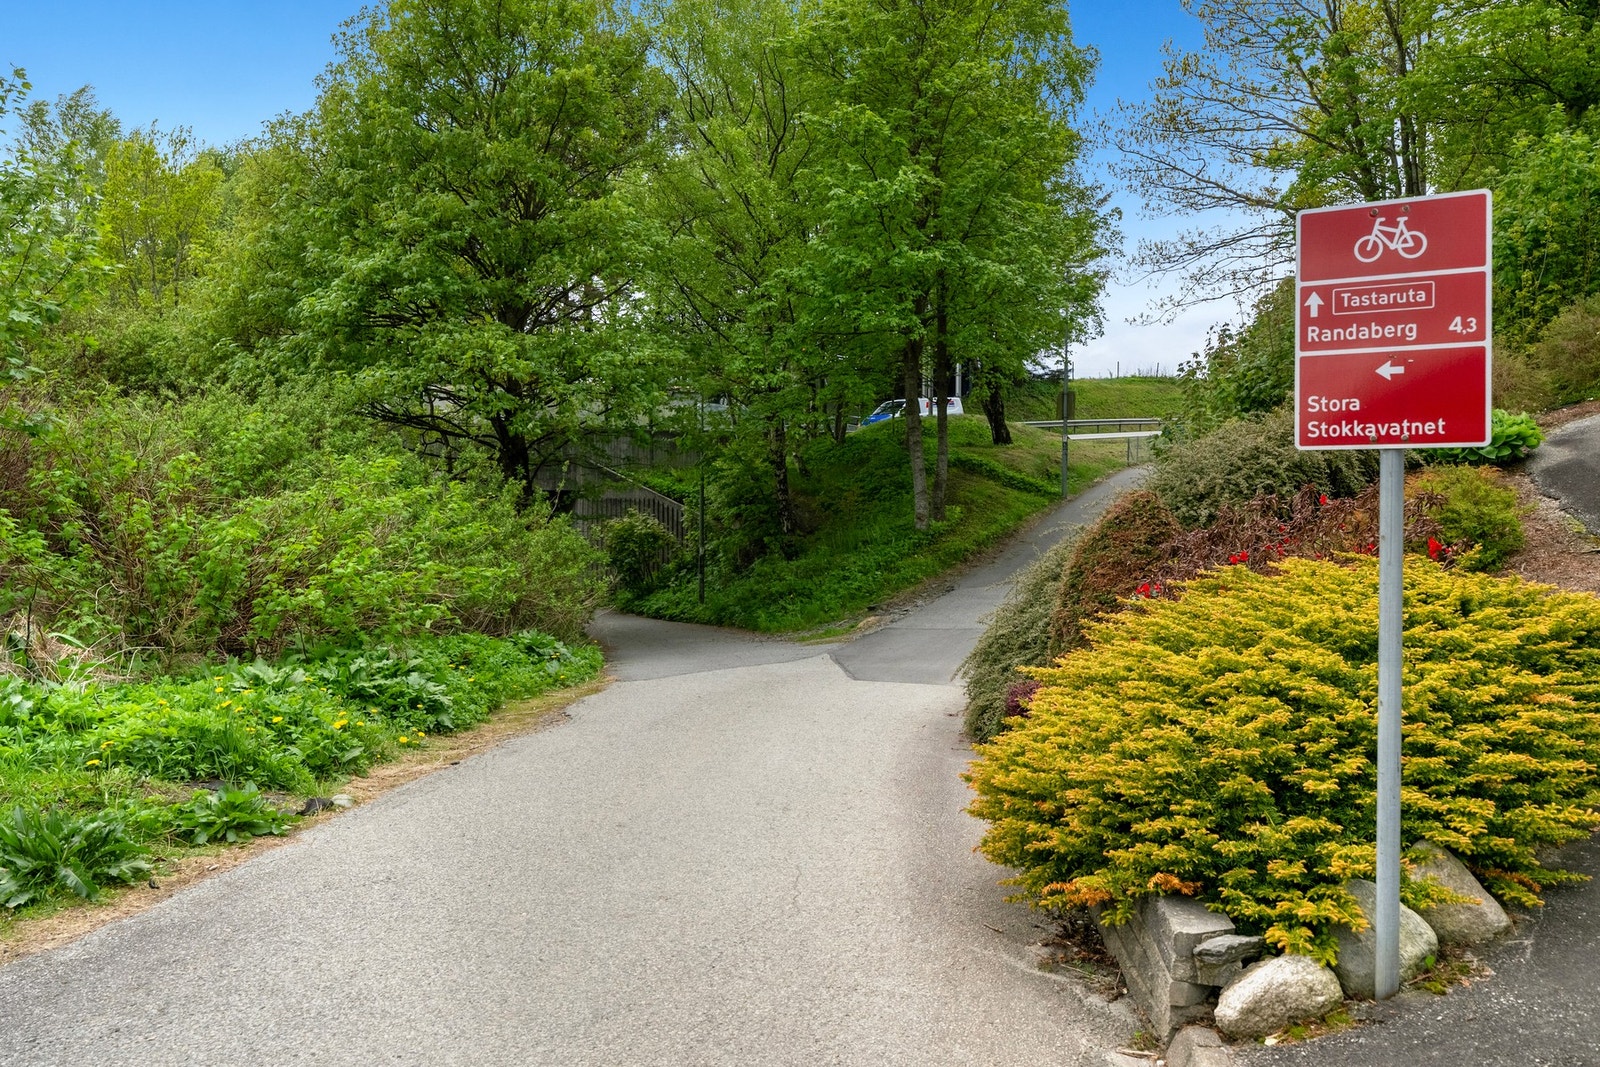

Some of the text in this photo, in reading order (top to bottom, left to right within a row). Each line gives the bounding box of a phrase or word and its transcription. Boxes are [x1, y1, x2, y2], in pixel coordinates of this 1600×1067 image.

[1341, 289, 1426, 307] Tastaruta
[1307, 316, 1477, 342] Randaberg 4,3
[1307, 395, 1360, 413] Stora
[1307, 418, 1446, 438] Stokkavatnet
